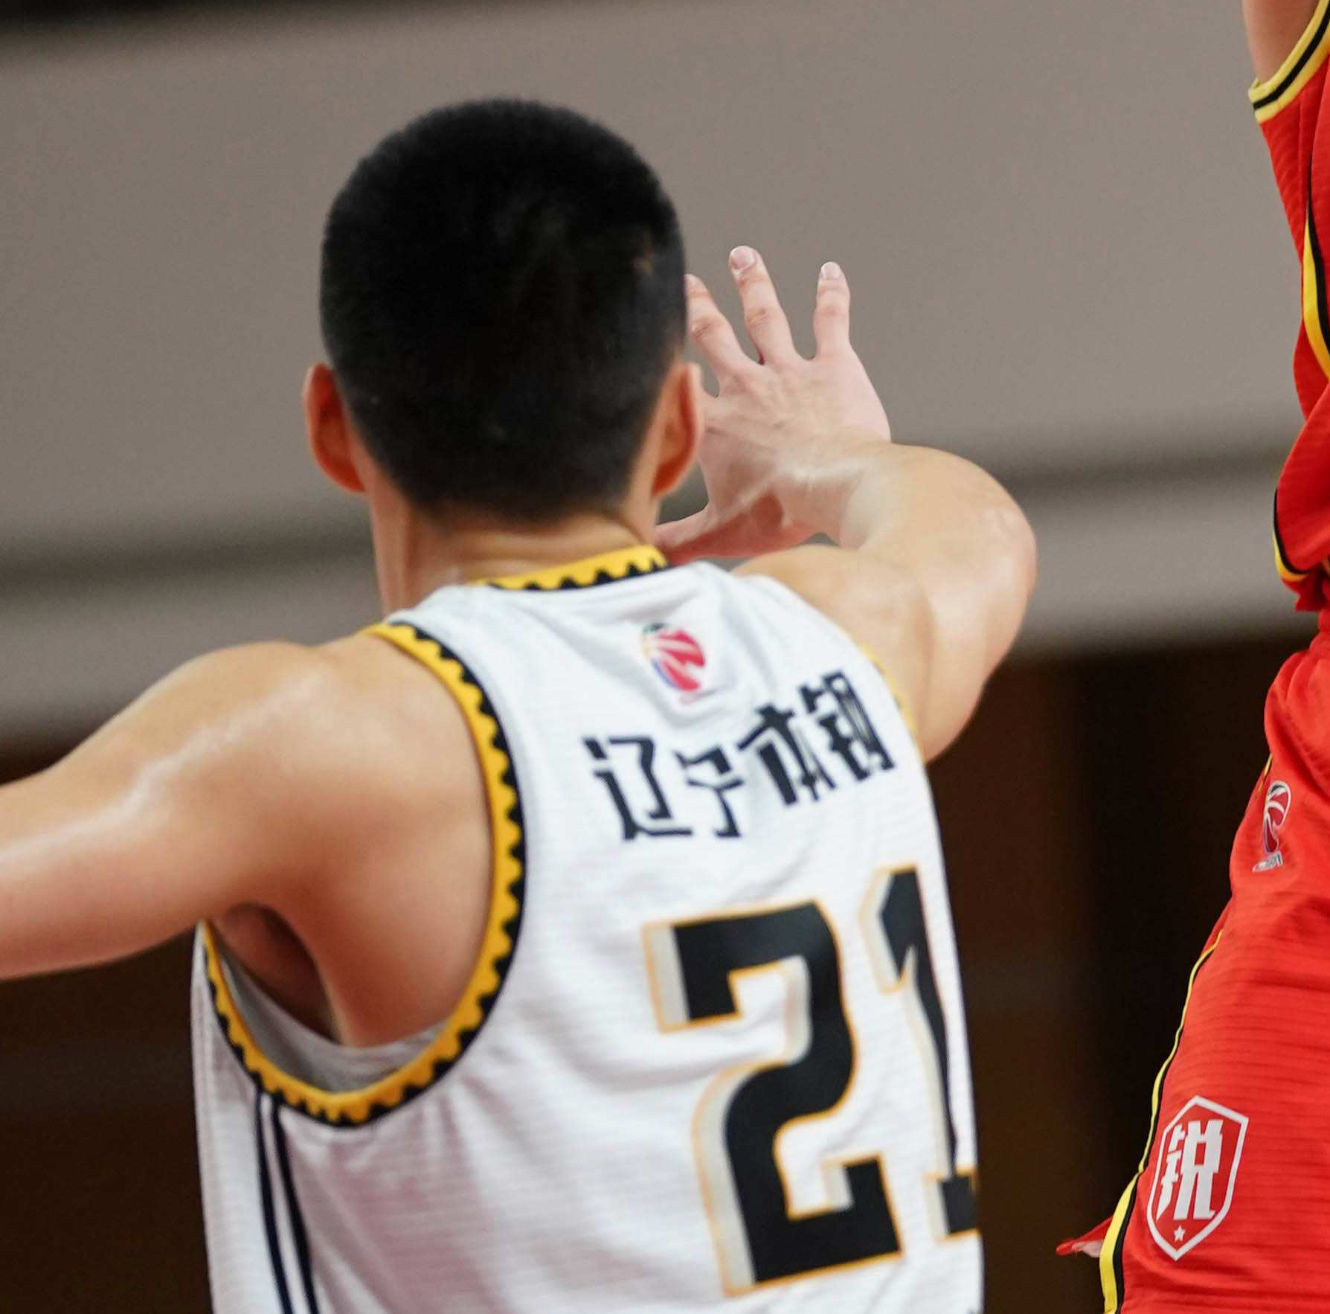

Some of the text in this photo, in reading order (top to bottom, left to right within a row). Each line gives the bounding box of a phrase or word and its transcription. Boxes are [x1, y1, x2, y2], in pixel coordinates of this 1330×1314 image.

[582, 670, 895, 840] 辽宁本钢
[642, 864, 979, 1297] 21
